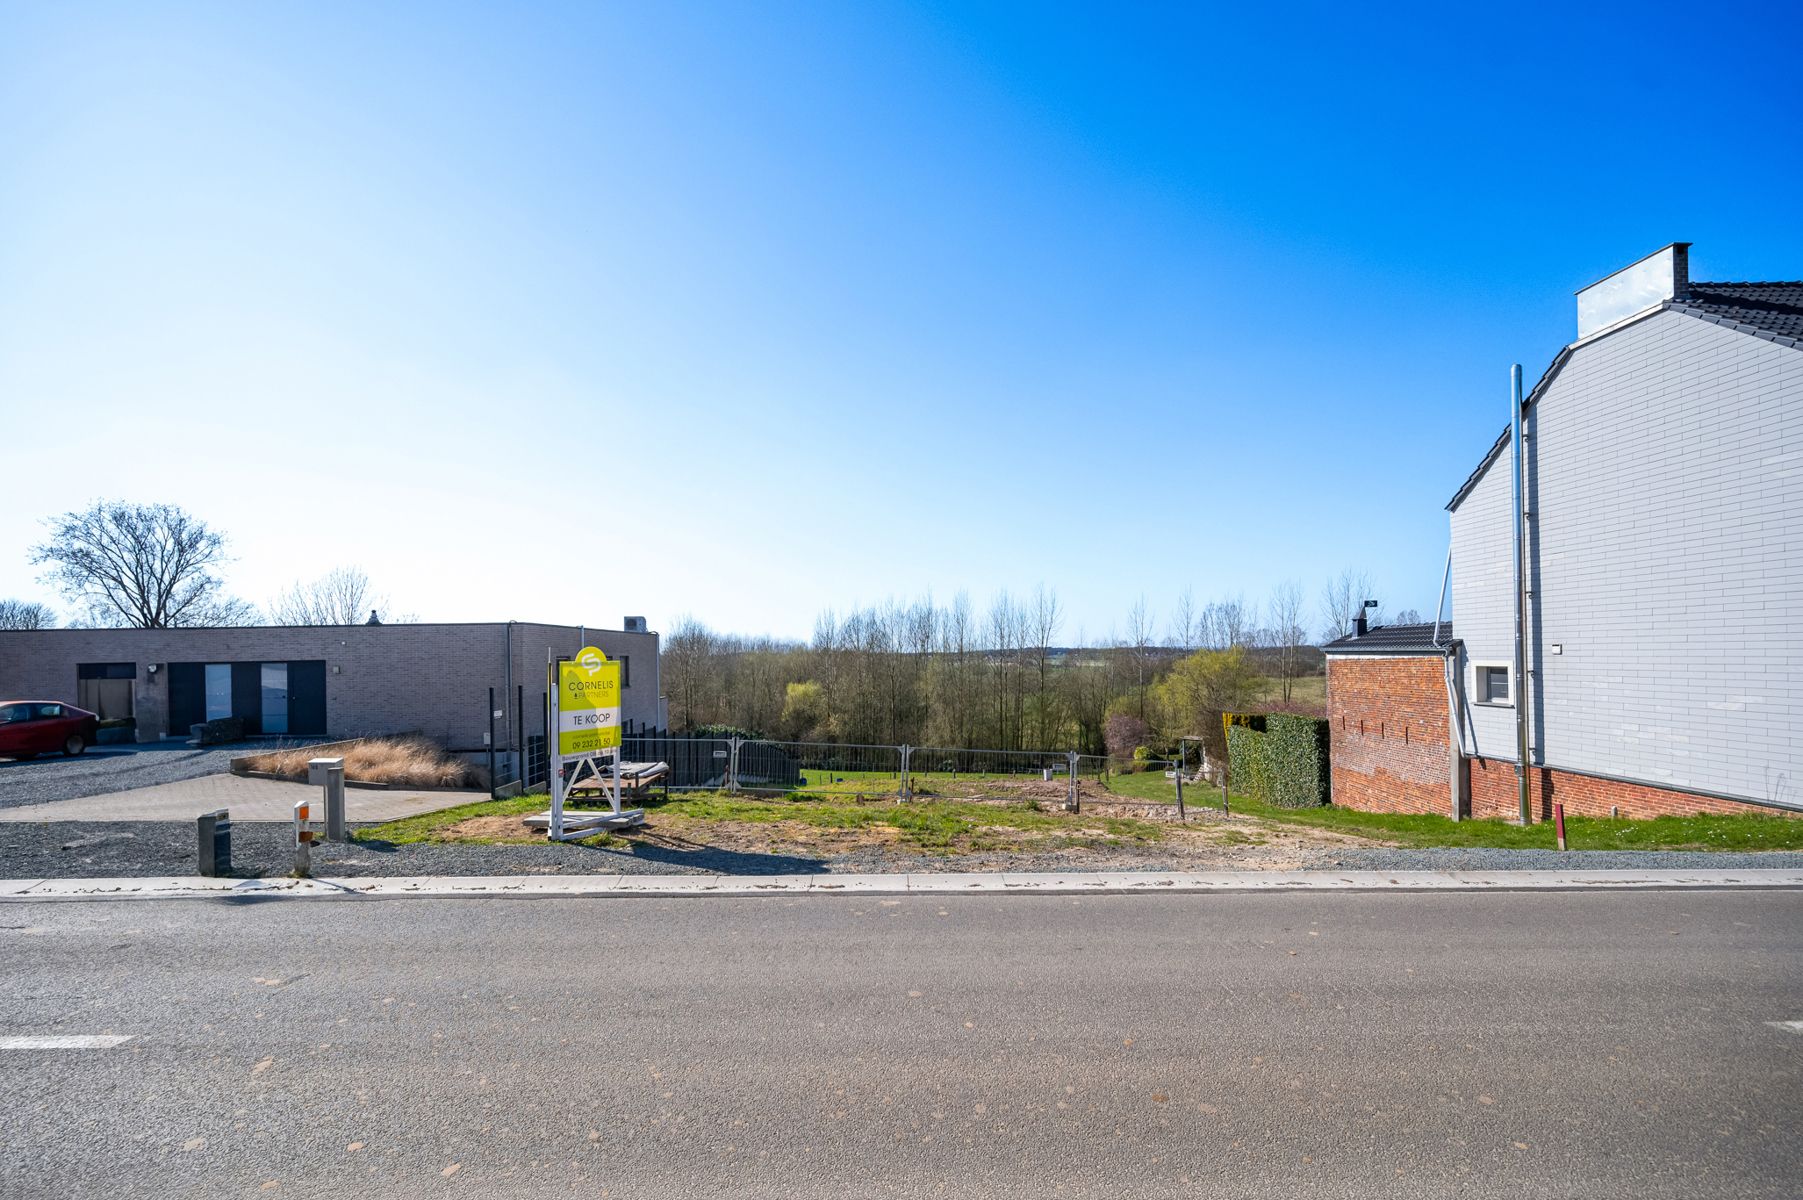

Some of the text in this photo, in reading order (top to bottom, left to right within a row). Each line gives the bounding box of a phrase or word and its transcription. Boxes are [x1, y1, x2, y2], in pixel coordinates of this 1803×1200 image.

[568, 680, 613, 691] CORNELIS
[573, 714, 610, 725] TE KOOP
[582, 740, 593, 748] 232
[604, 737, 610, 745] 50
